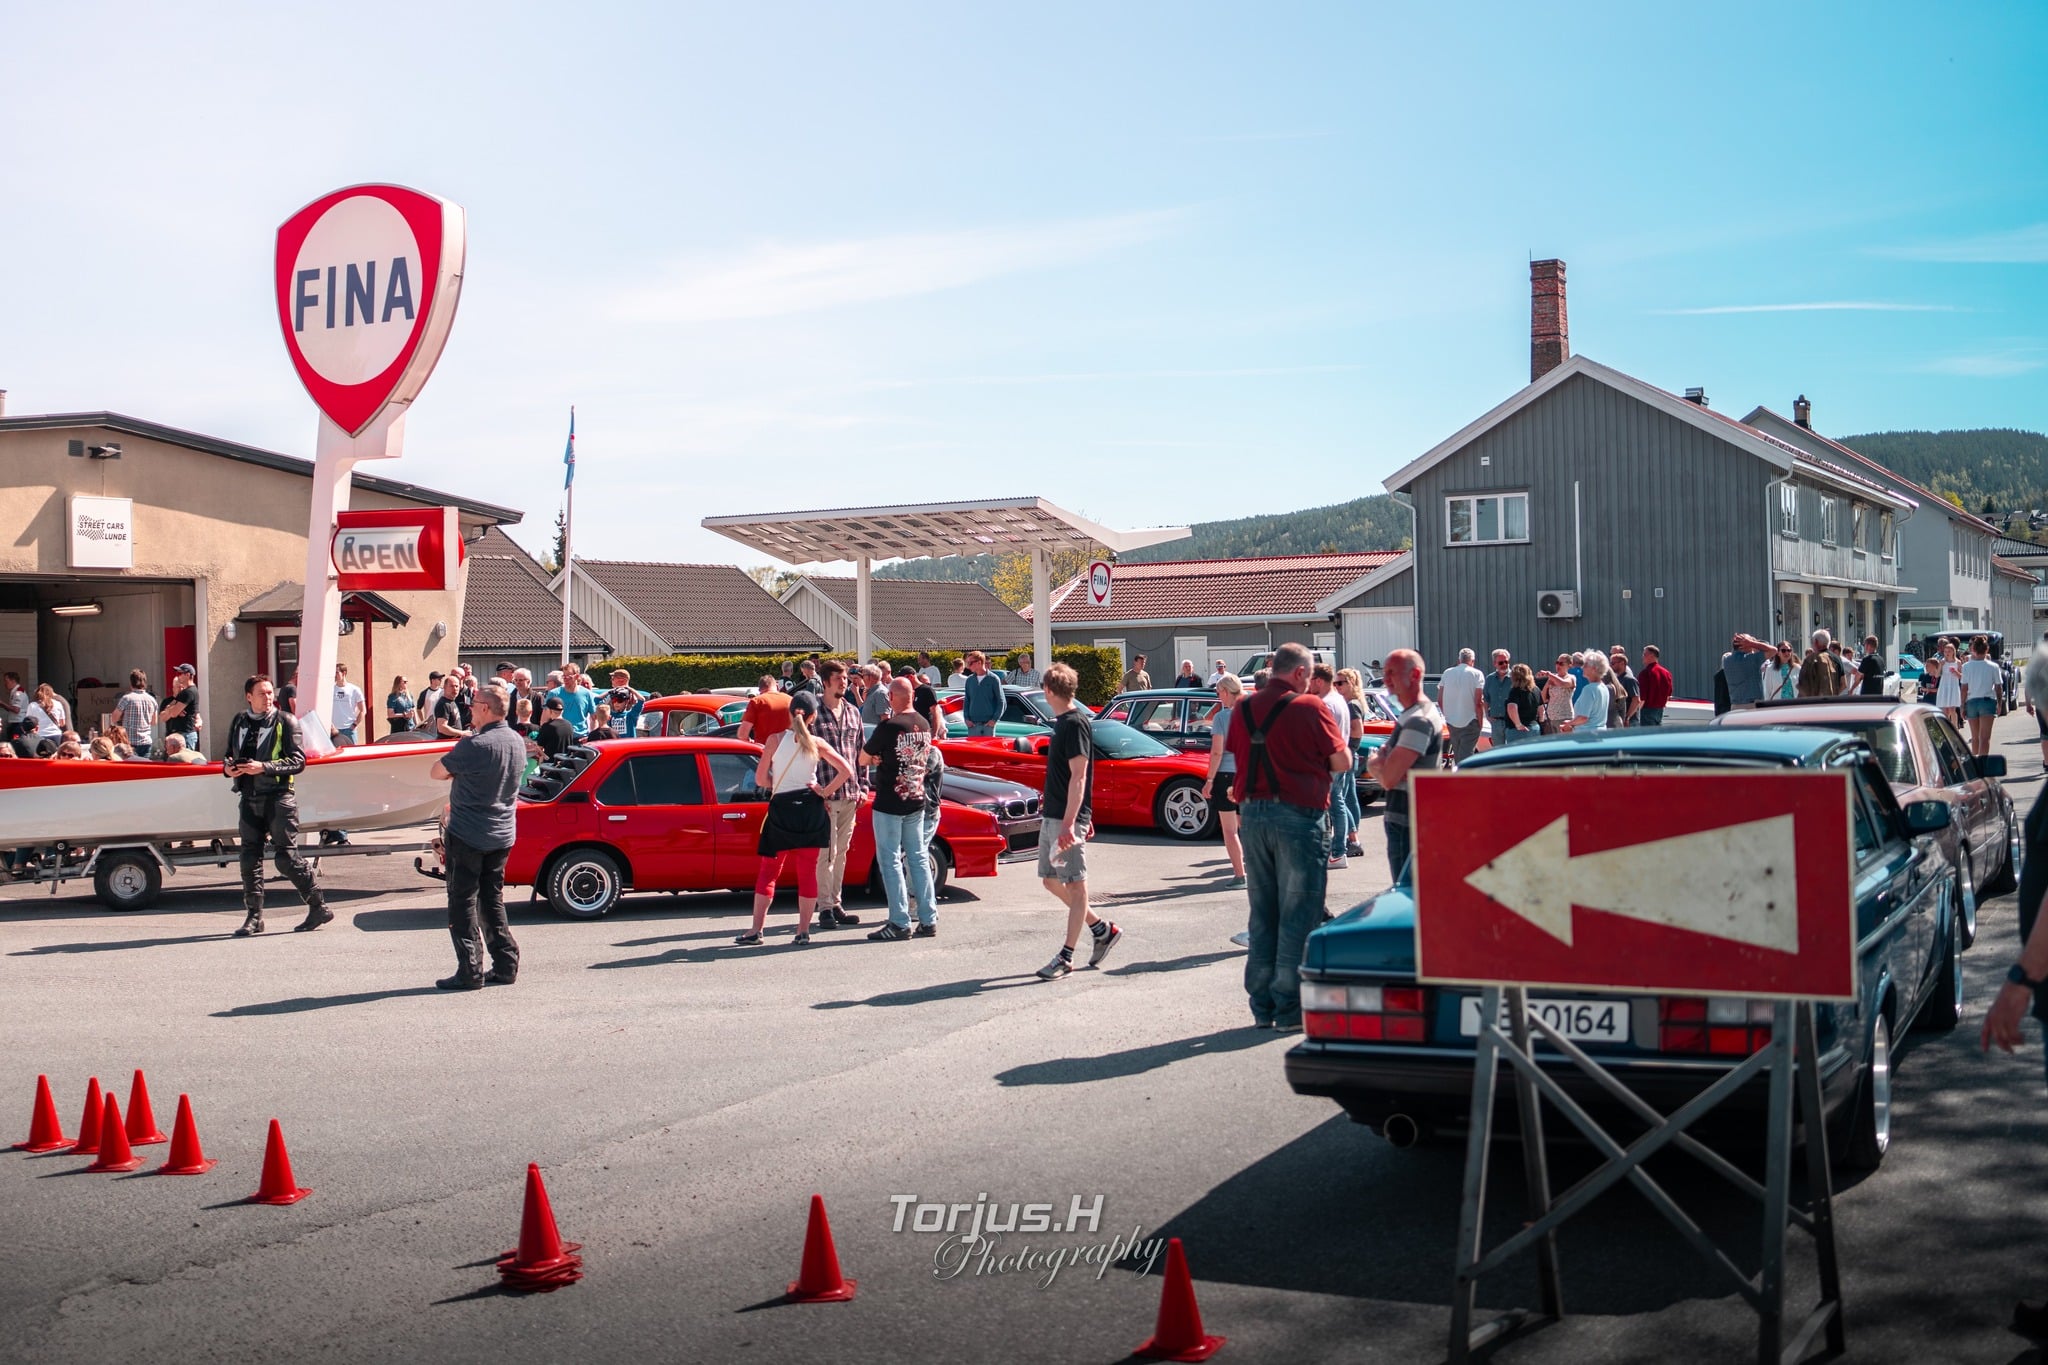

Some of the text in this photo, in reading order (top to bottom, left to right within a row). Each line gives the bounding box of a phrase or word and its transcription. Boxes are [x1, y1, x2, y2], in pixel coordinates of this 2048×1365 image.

[295, 257, 415, 332] FINA
[79, 521, 105, 529] STREET
[105, 533, 127, 541] LUNDE
[342, 536, 417, 571] ÅPEN
[1093, 574, 1108, 586] FINA
